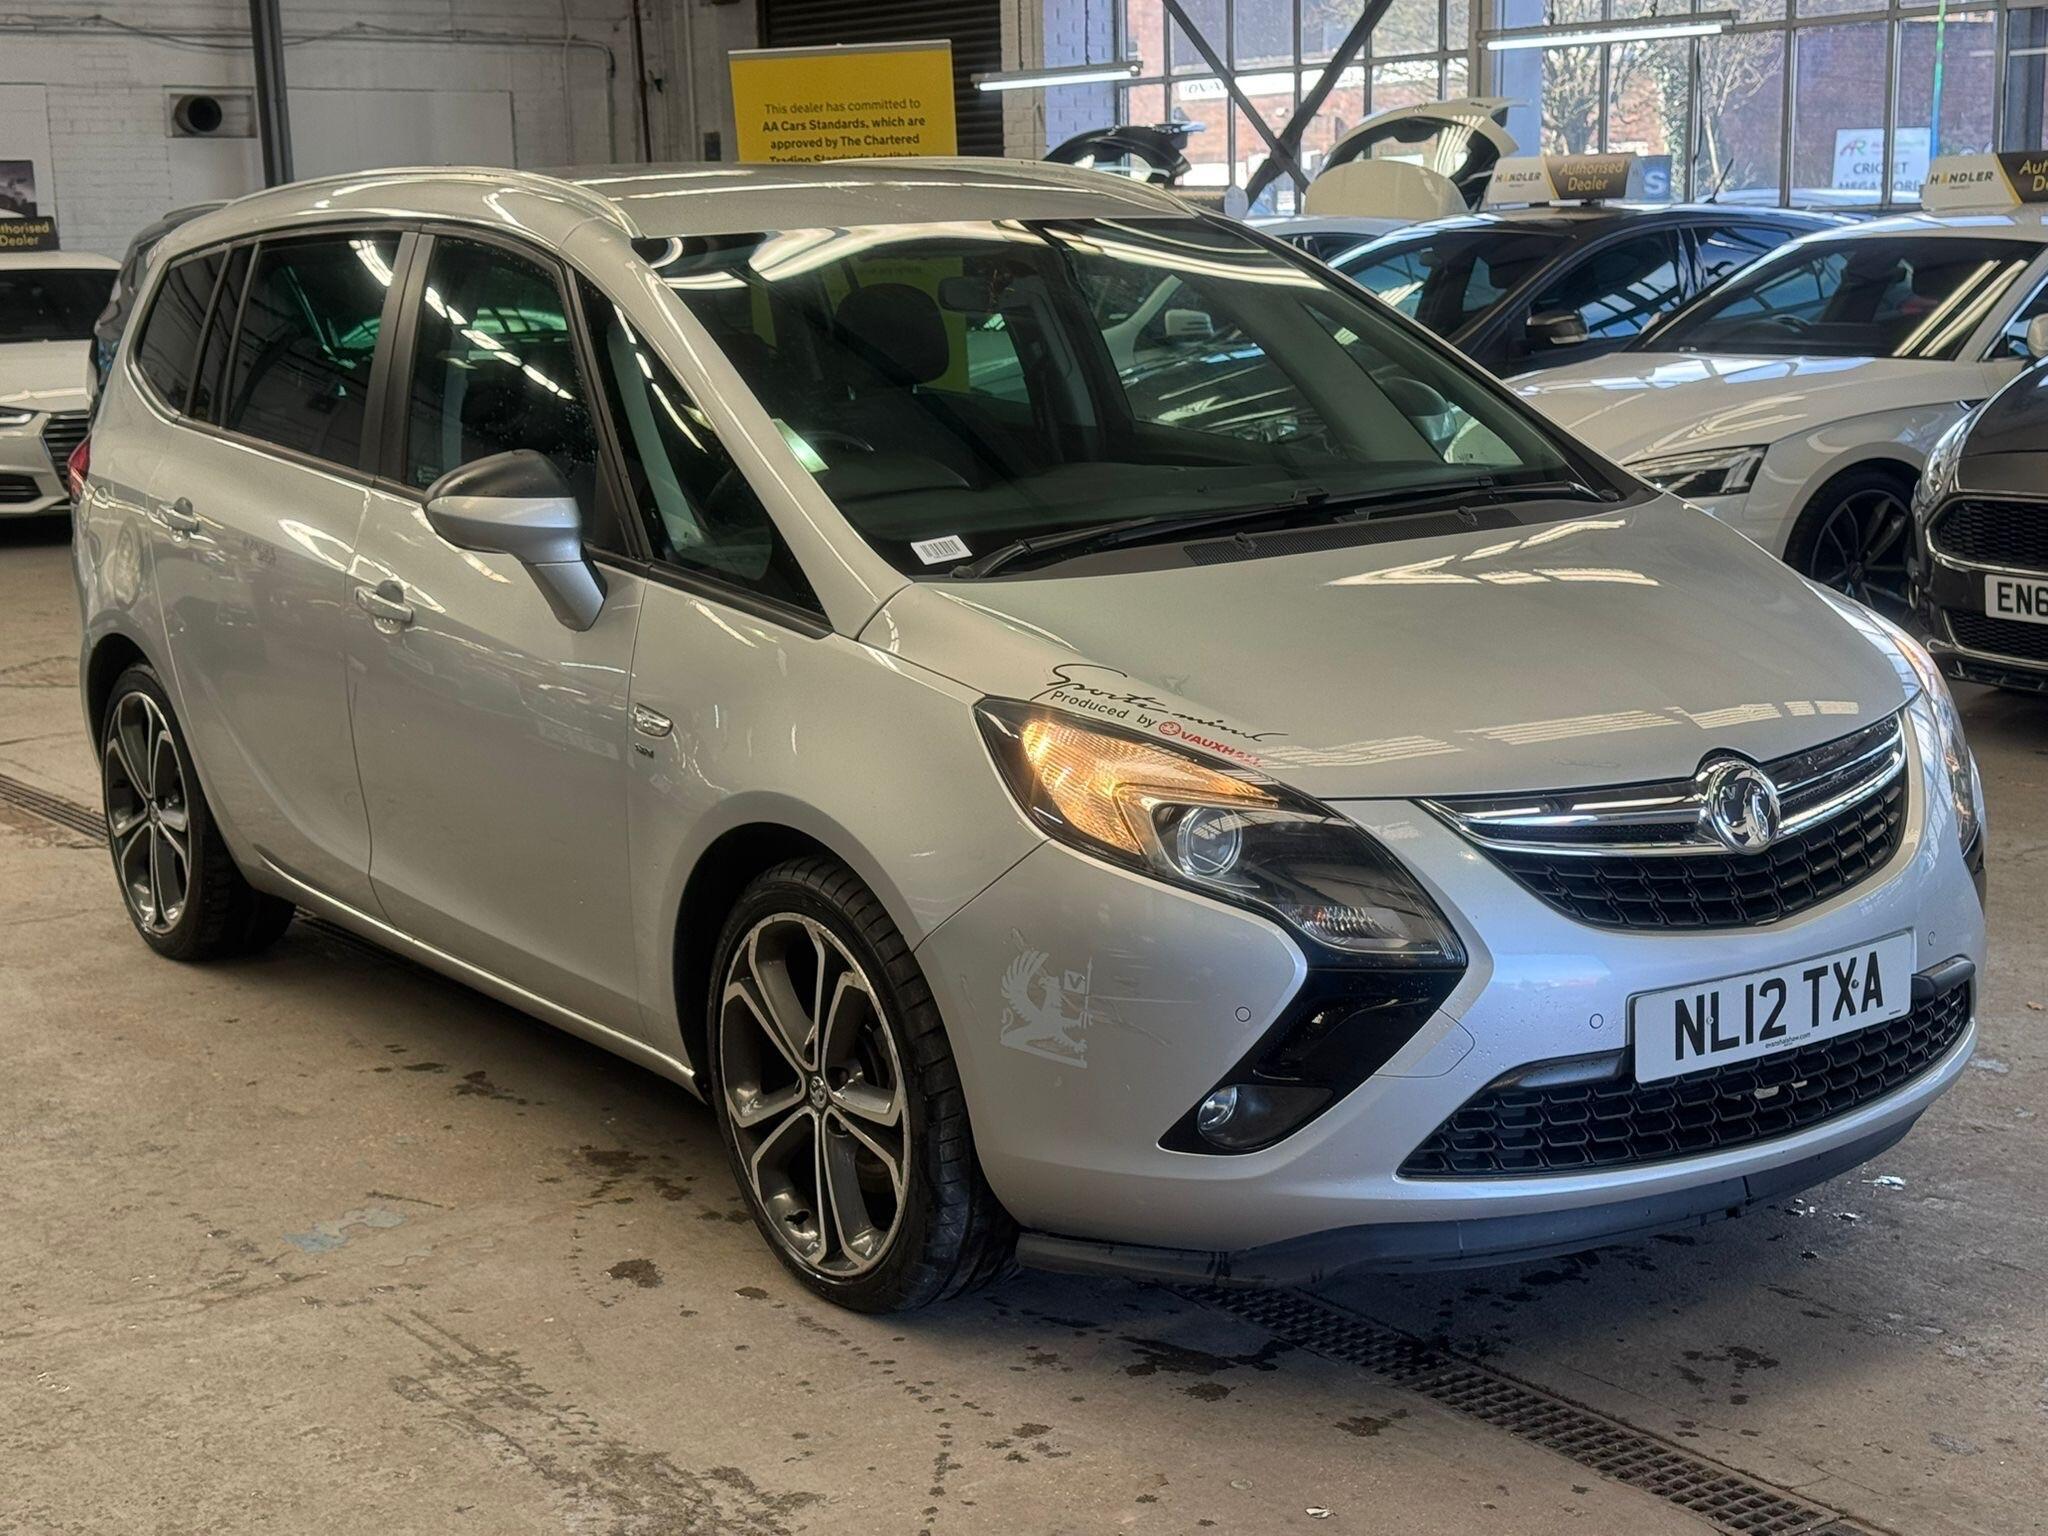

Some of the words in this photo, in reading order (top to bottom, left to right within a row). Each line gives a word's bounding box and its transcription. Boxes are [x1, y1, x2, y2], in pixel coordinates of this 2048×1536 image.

[765, 103, 787, 114] This
[789, 102, 824, 113] dealer
[826, 101, 846, 112] has
[847, 99, 907, 111] committed
[909, 98, 921, 109] to
[763, 121, 779, 132] AA
[781, 120, 807, 131] Cars
[872, 116, 905, 128] which
[907, 117, 926, 126] are
[770, 137, 822, 151] approved
[825, 137, 838, 149] by
[840, 135, 862, 147] The
[864, 133, 920, 146] Chartered
[1559, 160, 1625, 176] Authorised
[1567, 176, 1609, 192] Dealer
[1050, 690, 1130, 719] Produced
[1136, 713, 1158, 729] by
[1674, 977, 1787, 1062] NL12
[1803, 951, 1884, 1028] TXA
